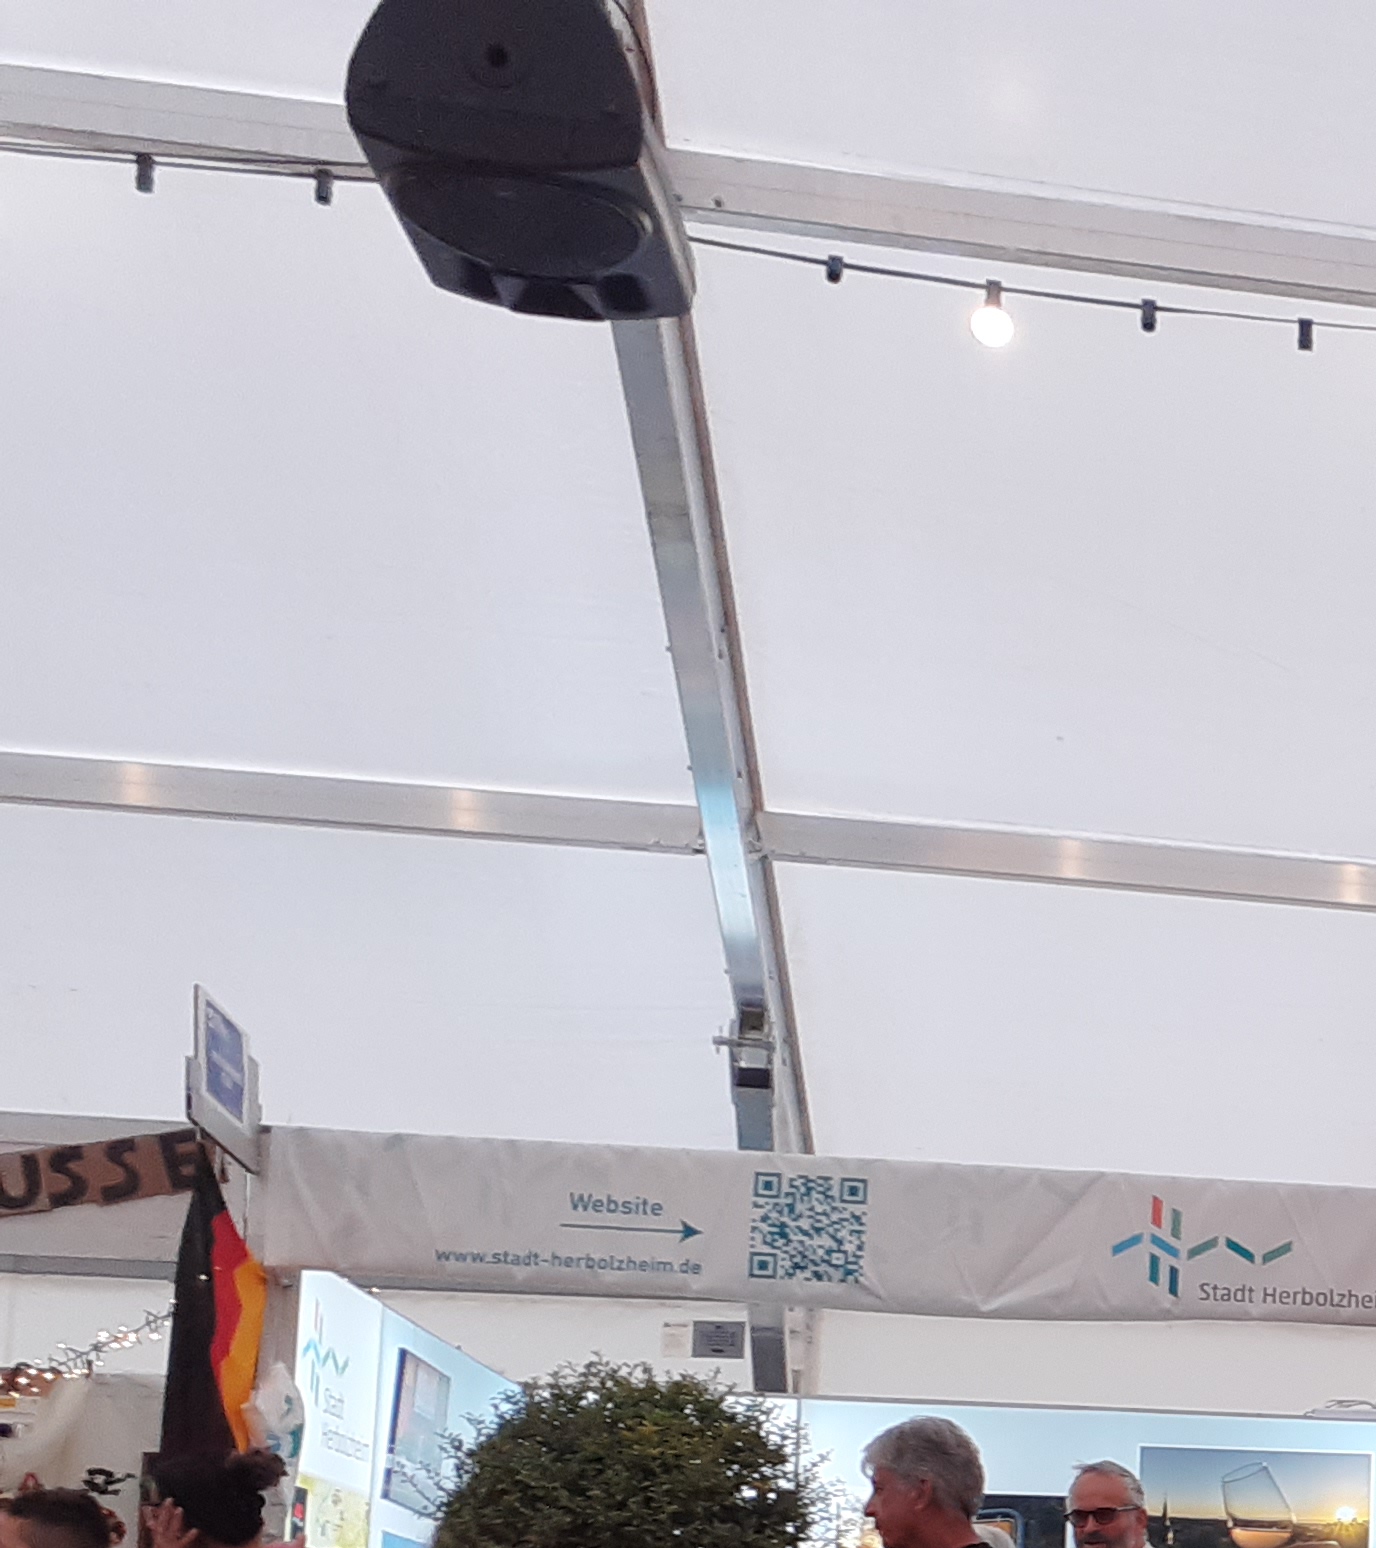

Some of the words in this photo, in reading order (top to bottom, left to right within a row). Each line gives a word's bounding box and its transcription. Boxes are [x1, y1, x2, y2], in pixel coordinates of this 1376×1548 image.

[569, 1192, 664, 1217] Website
[434, 1249, 702, 1276] www.stadt-herbolzheim.de
[1198, 1282, 1255, 1304] Stadt
